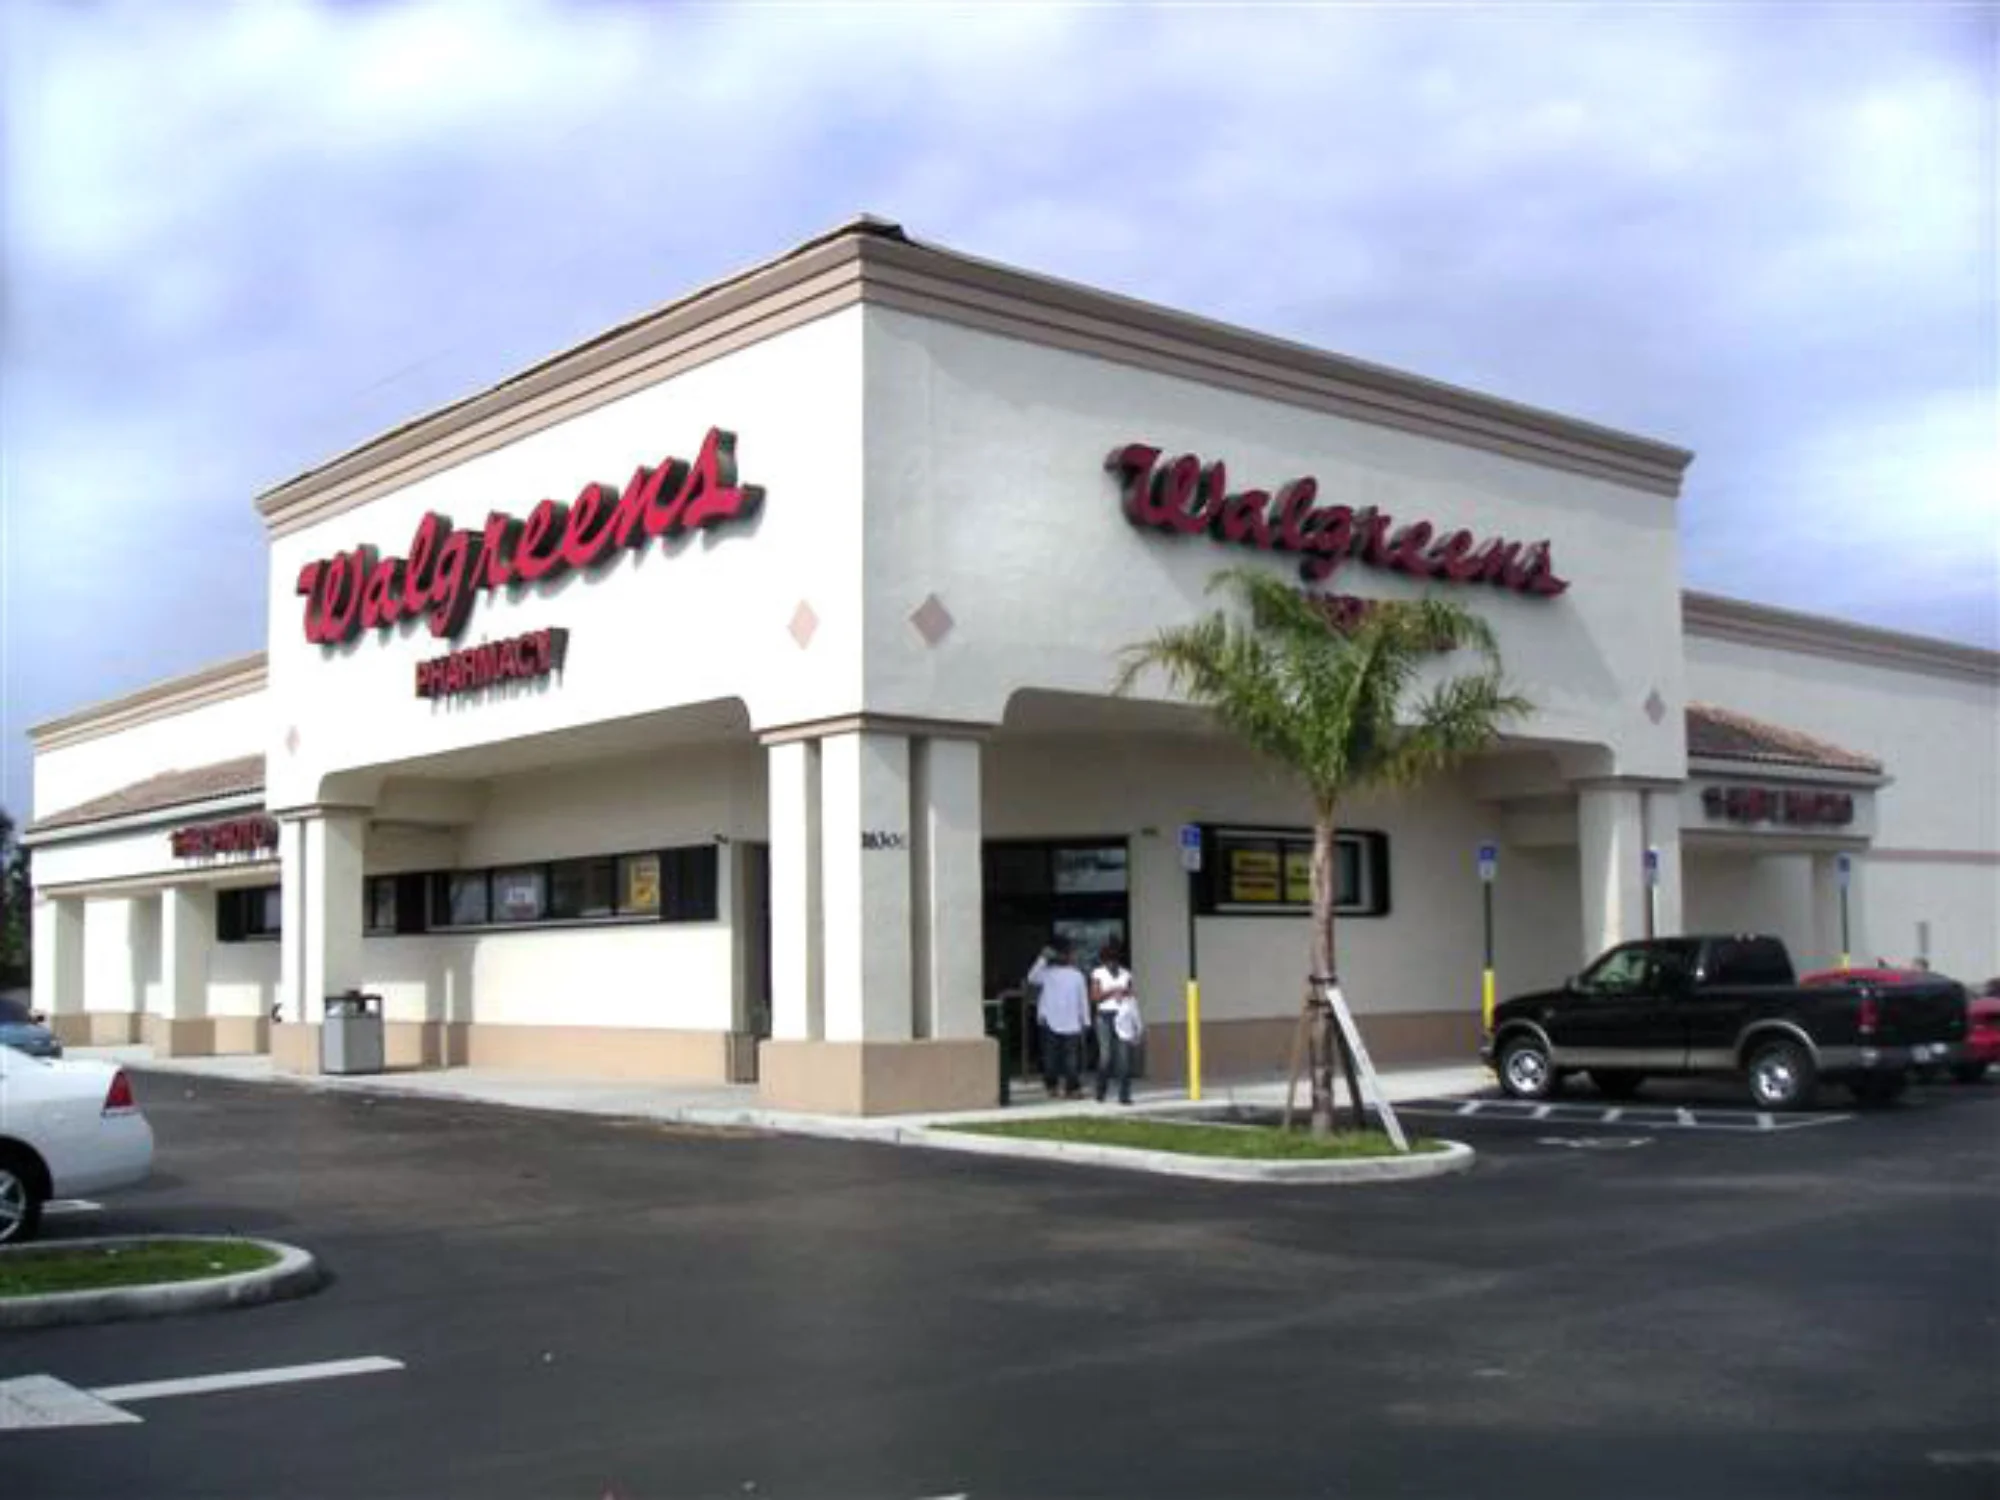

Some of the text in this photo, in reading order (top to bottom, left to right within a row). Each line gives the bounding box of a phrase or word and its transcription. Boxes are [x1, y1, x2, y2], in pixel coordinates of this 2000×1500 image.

[297, 426, 764, 644] Walgreens
[1105, 443, 1571, 597] Walgreens
[415, 629, 564, 698] PHARMACY
